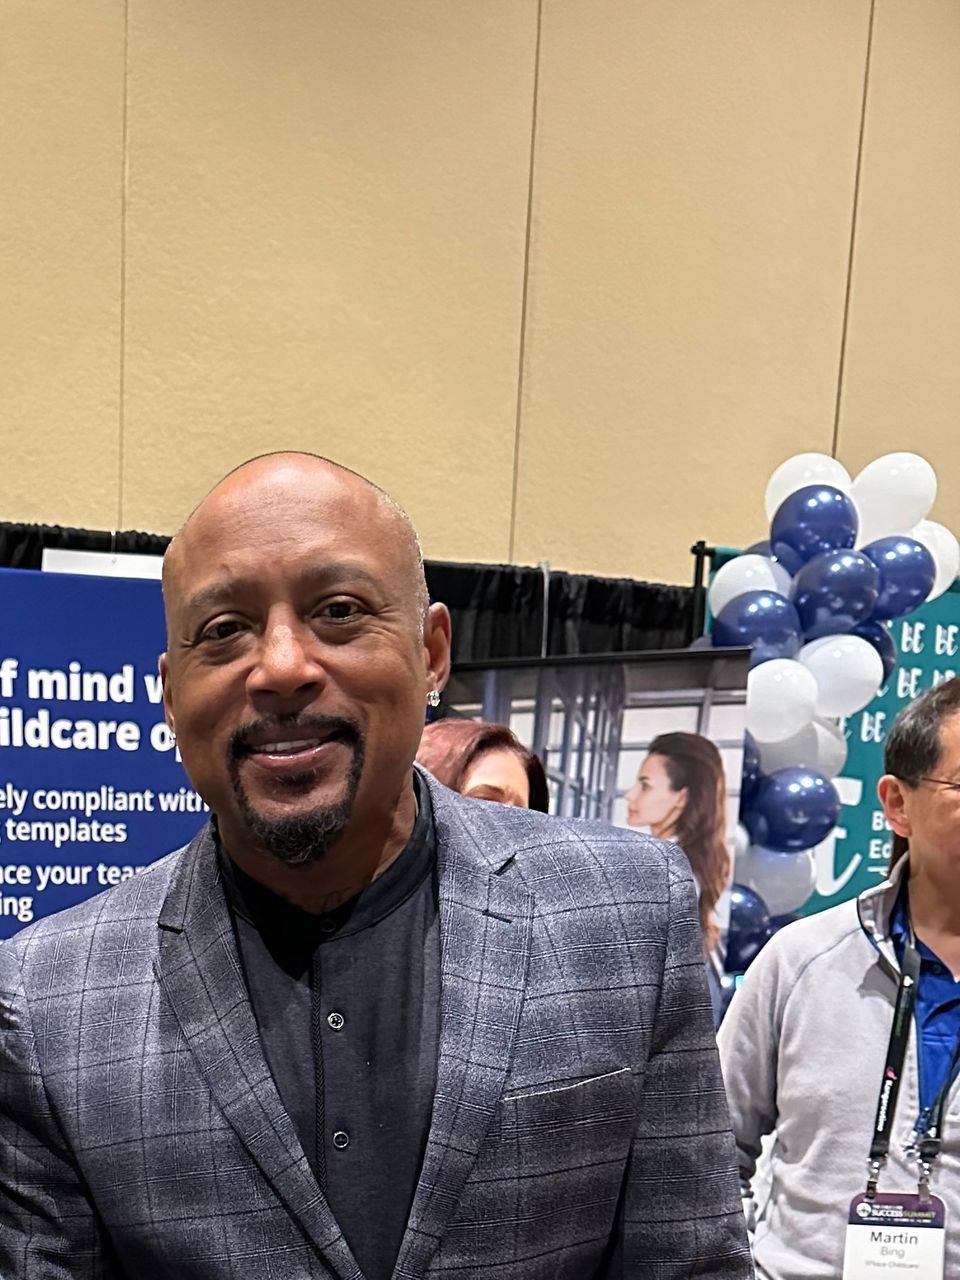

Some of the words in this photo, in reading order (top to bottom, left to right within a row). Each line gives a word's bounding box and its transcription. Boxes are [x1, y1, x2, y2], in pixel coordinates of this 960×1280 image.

[28, 661, 135, 703] mind
[33, 785, 155, 817] compliant
[6, 817, 127, 848] templates
[36, 864, 93, 891] your
[870, 1231, 918, 1245] Martin
[880, 1246, 906, 1259] Bing
